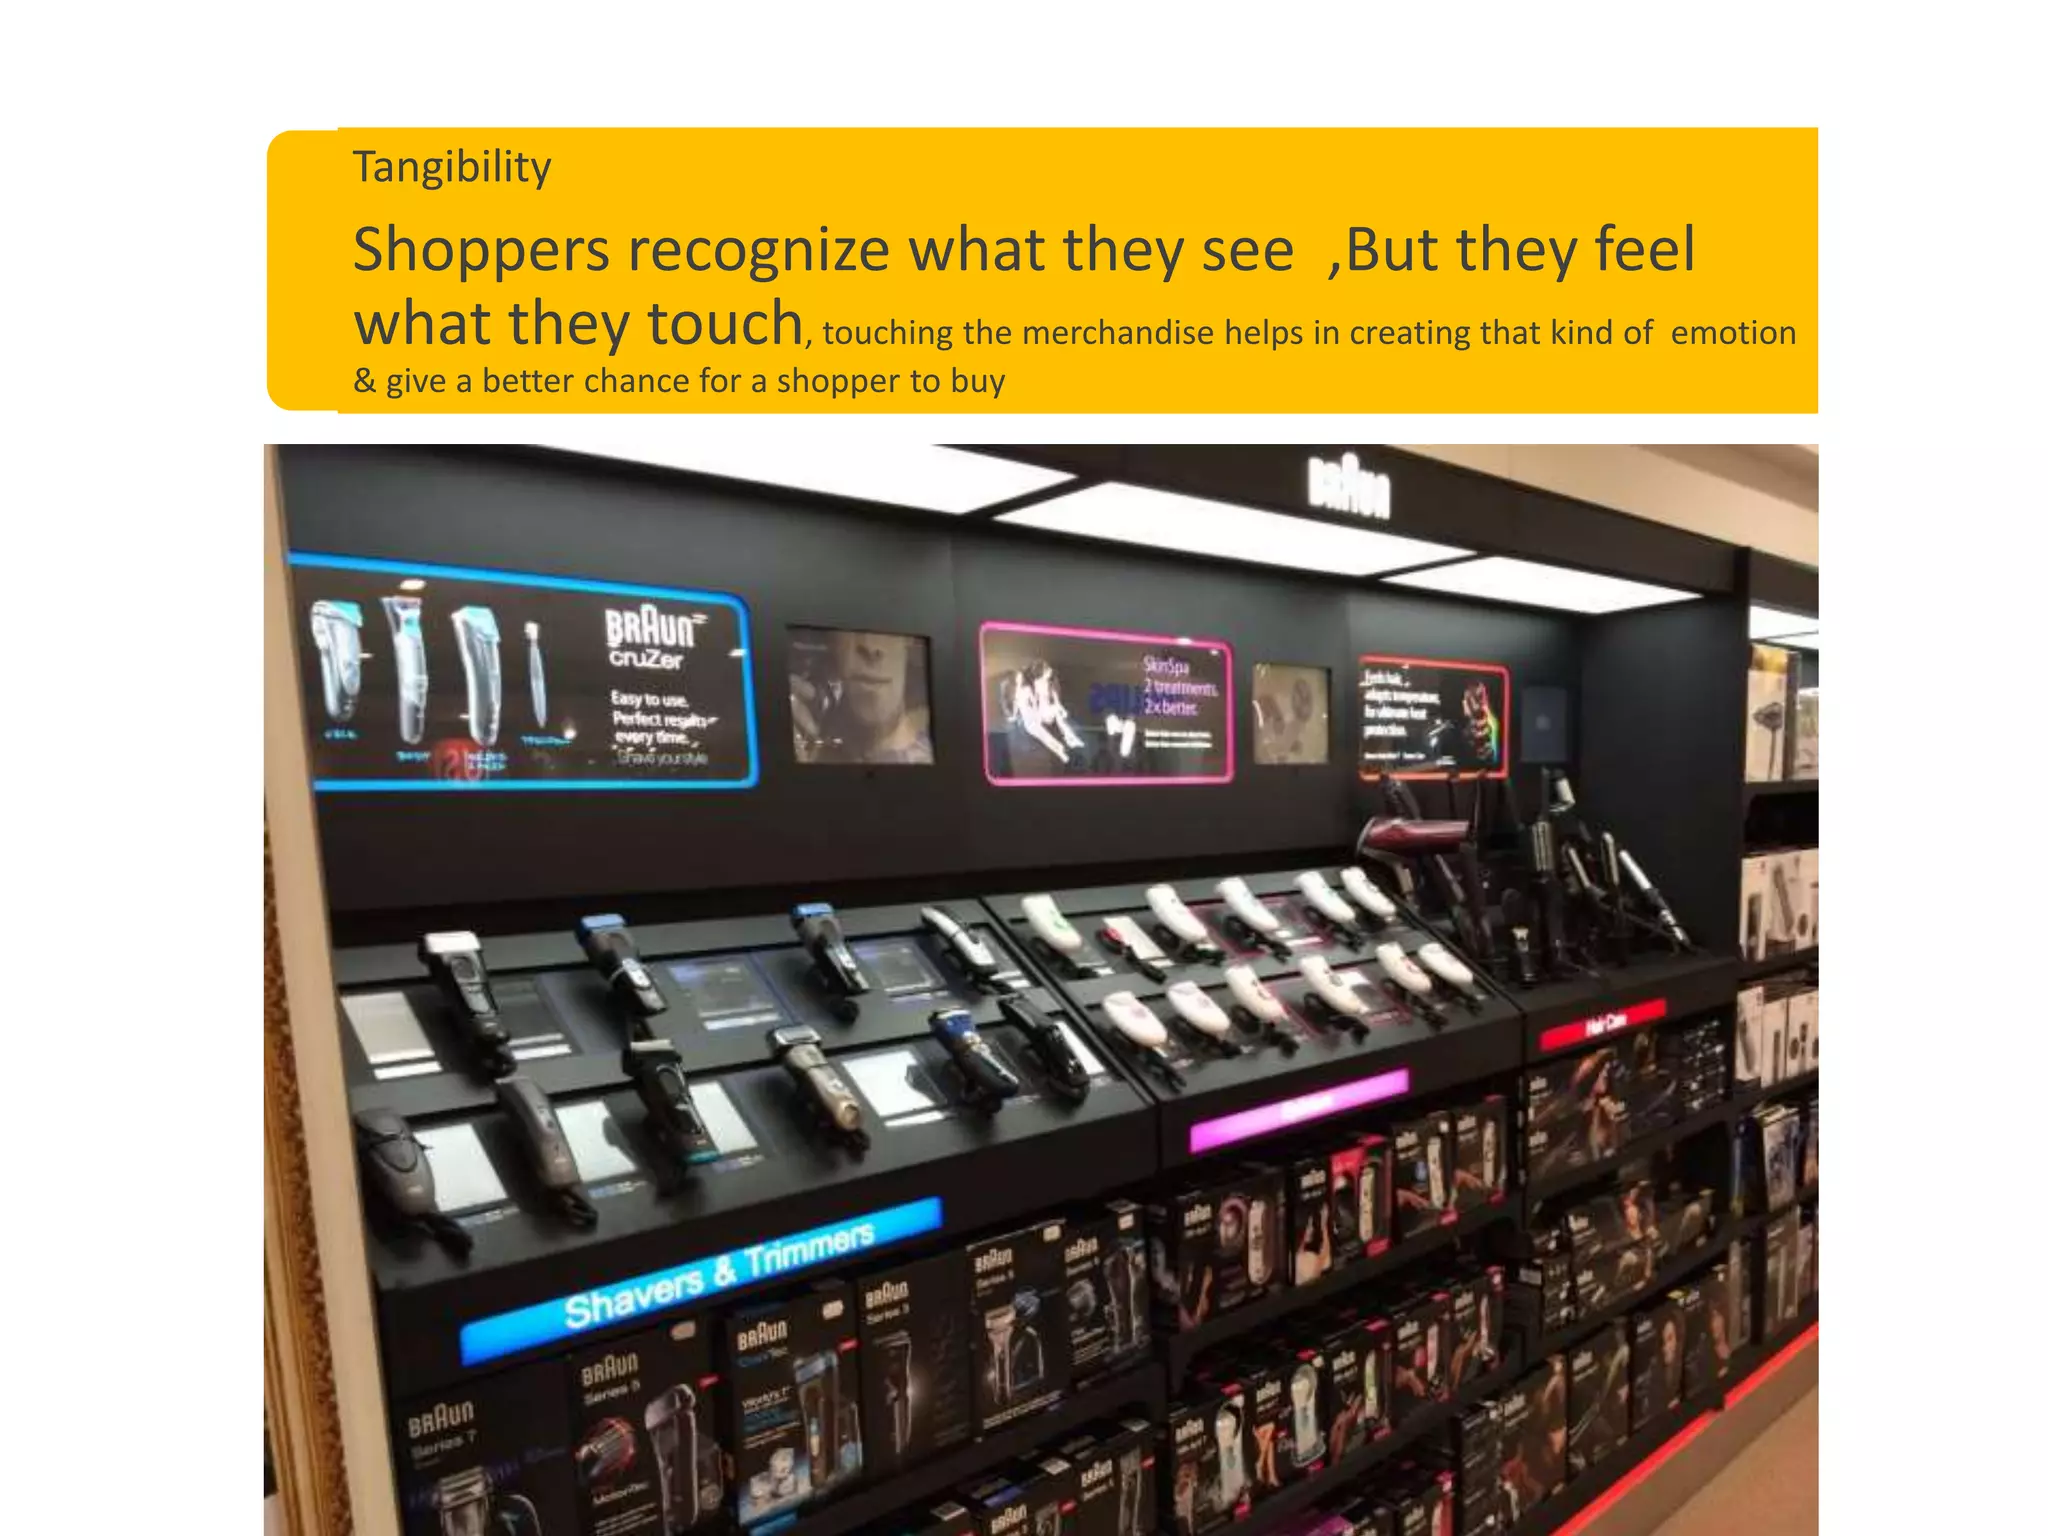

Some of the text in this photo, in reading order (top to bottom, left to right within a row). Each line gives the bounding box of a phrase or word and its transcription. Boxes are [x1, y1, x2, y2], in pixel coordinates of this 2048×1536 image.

[605, 604, 694, 647] BRAUN
[611, 689, 642, 708] Easy
[644, 693, 659, 705] to
[613, 710, 662, 727] Perfect
[615, 730, 654, 746] every
[564, 1222, 875, 1328] Shavers & Trimmers
[581, 1352, 639, 1388] BRAUN
[408, 1401, 475, 1438] BRAUN
